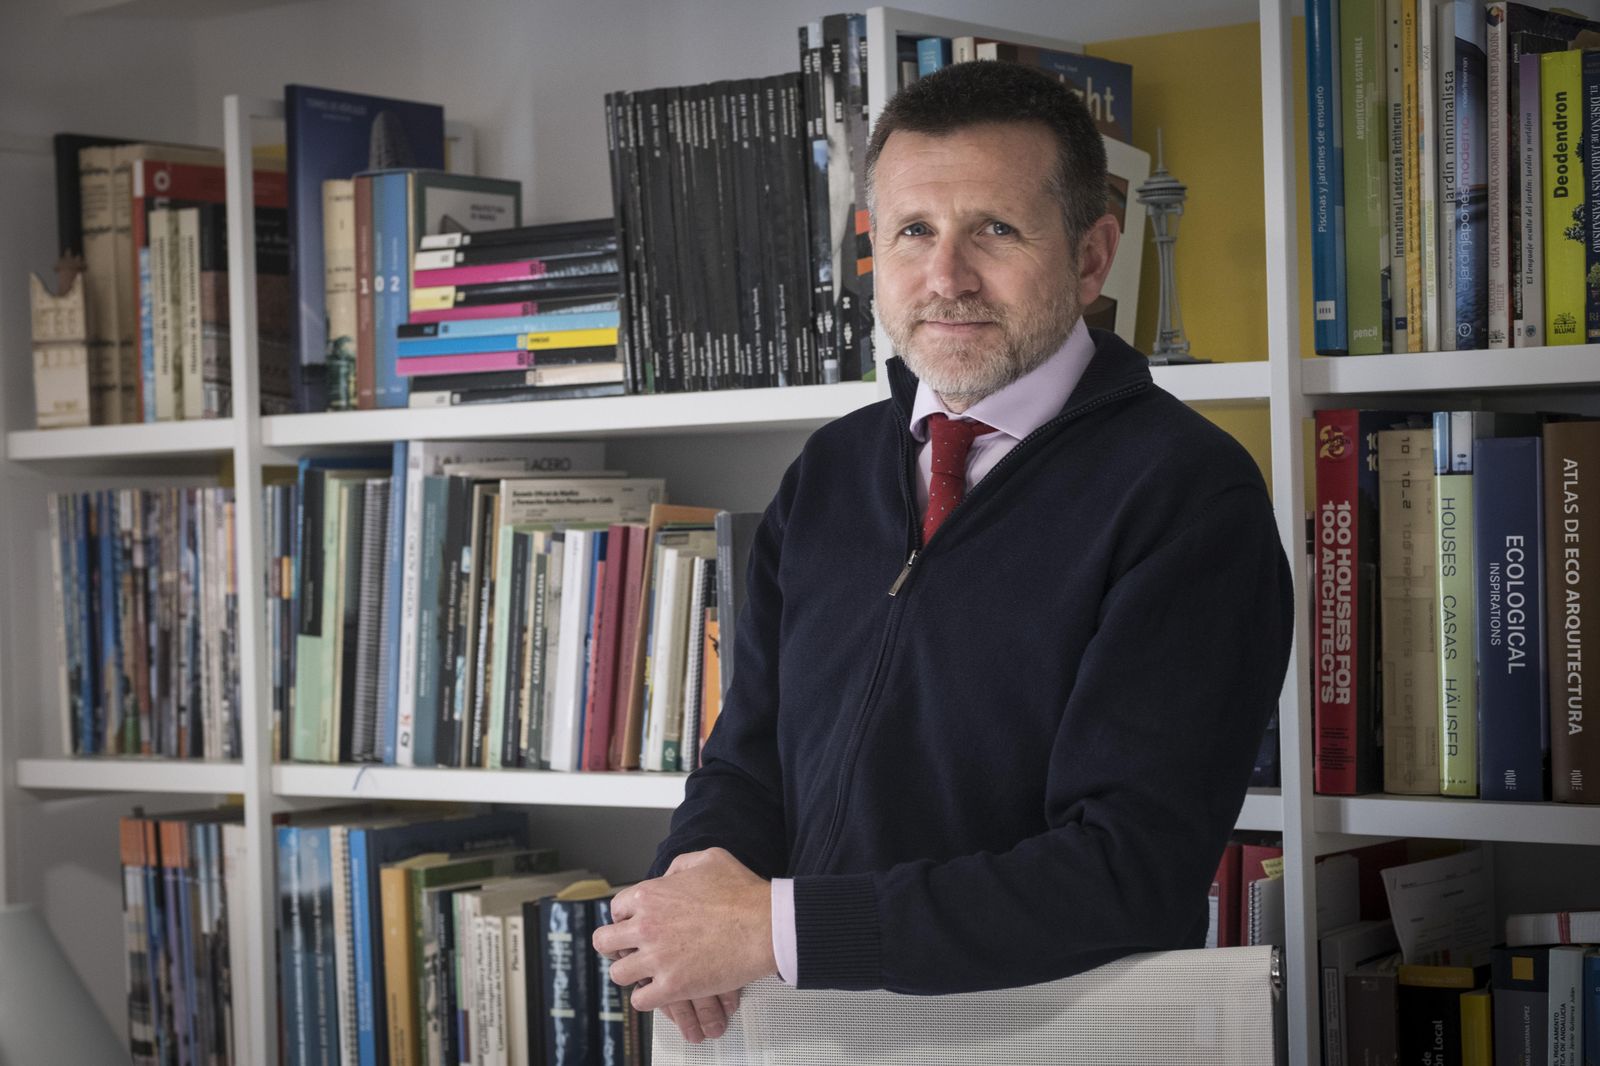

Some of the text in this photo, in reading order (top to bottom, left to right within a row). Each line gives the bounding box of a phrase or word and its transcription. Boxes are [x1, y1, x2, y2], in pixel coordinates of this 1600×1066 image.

[1489, 32, 1500, 64] JARDÍN
[1355, 36, 1366, 140] ARQUITECTURA SOSTENIBLE
[1490, 87, 1500, 118] COLOR
[1590, 85, 1599, 95] EL
[1442, 70, 1454, 155] minimalista
[1524, 112, 1533, 145] metáfora
[1490, 132, 1500, 176] COMBINAR
[1552, 90, 1569, 198] Deodendron
[1590, 133, 1599, 144] DE
[1314, 85, 1329, 233] Piscinas y jardines de ensueño
[1590, 144, 1600, 191] JARDINES
[1392, 102, 1405, 258] International Landscape Architecture
[1442, 161, 1456, 204] jardín
[1490, 178, 1500, 200] PARA
[1489, 201, 1500, 245] PRÁCTICA
[1525, 205, 1533, 214] del
[1591, 198, 1600, 254] PAISAJISMO
[1526, 215, 1534, 241] oculto
[1526, 242, 1535, 275] lenguaje
[360, 278, 369, 295] 1
[374, 275, 385, 293] 0
[390, 275, 400, 293] 2
[1526, 276, 1534, 285] El
[1554, 327, 1576, 335] BLUME
[1401, 436, 1411, 454] 10
[1401, 470, 1412, 509] 10_2
[1321, 500, 1336, 704] 100 ARCHITECTS
[1336, 500, 1352, 705] 100 HOUSES FOR
[1489, 562, 1502, 648] INSPIRATIONS
[1505, 534, 1526, 675] ECOLOGICAL
[1563, 458, 1583, 736] ATLAS DE ECO ARQUITECTURA
[1441, 497, 1461, 757] HOUSES CASAS HÄUSER
[1431, 1020, 1444, 1051] Local
[1422, 1051, 1432, 1066] de
